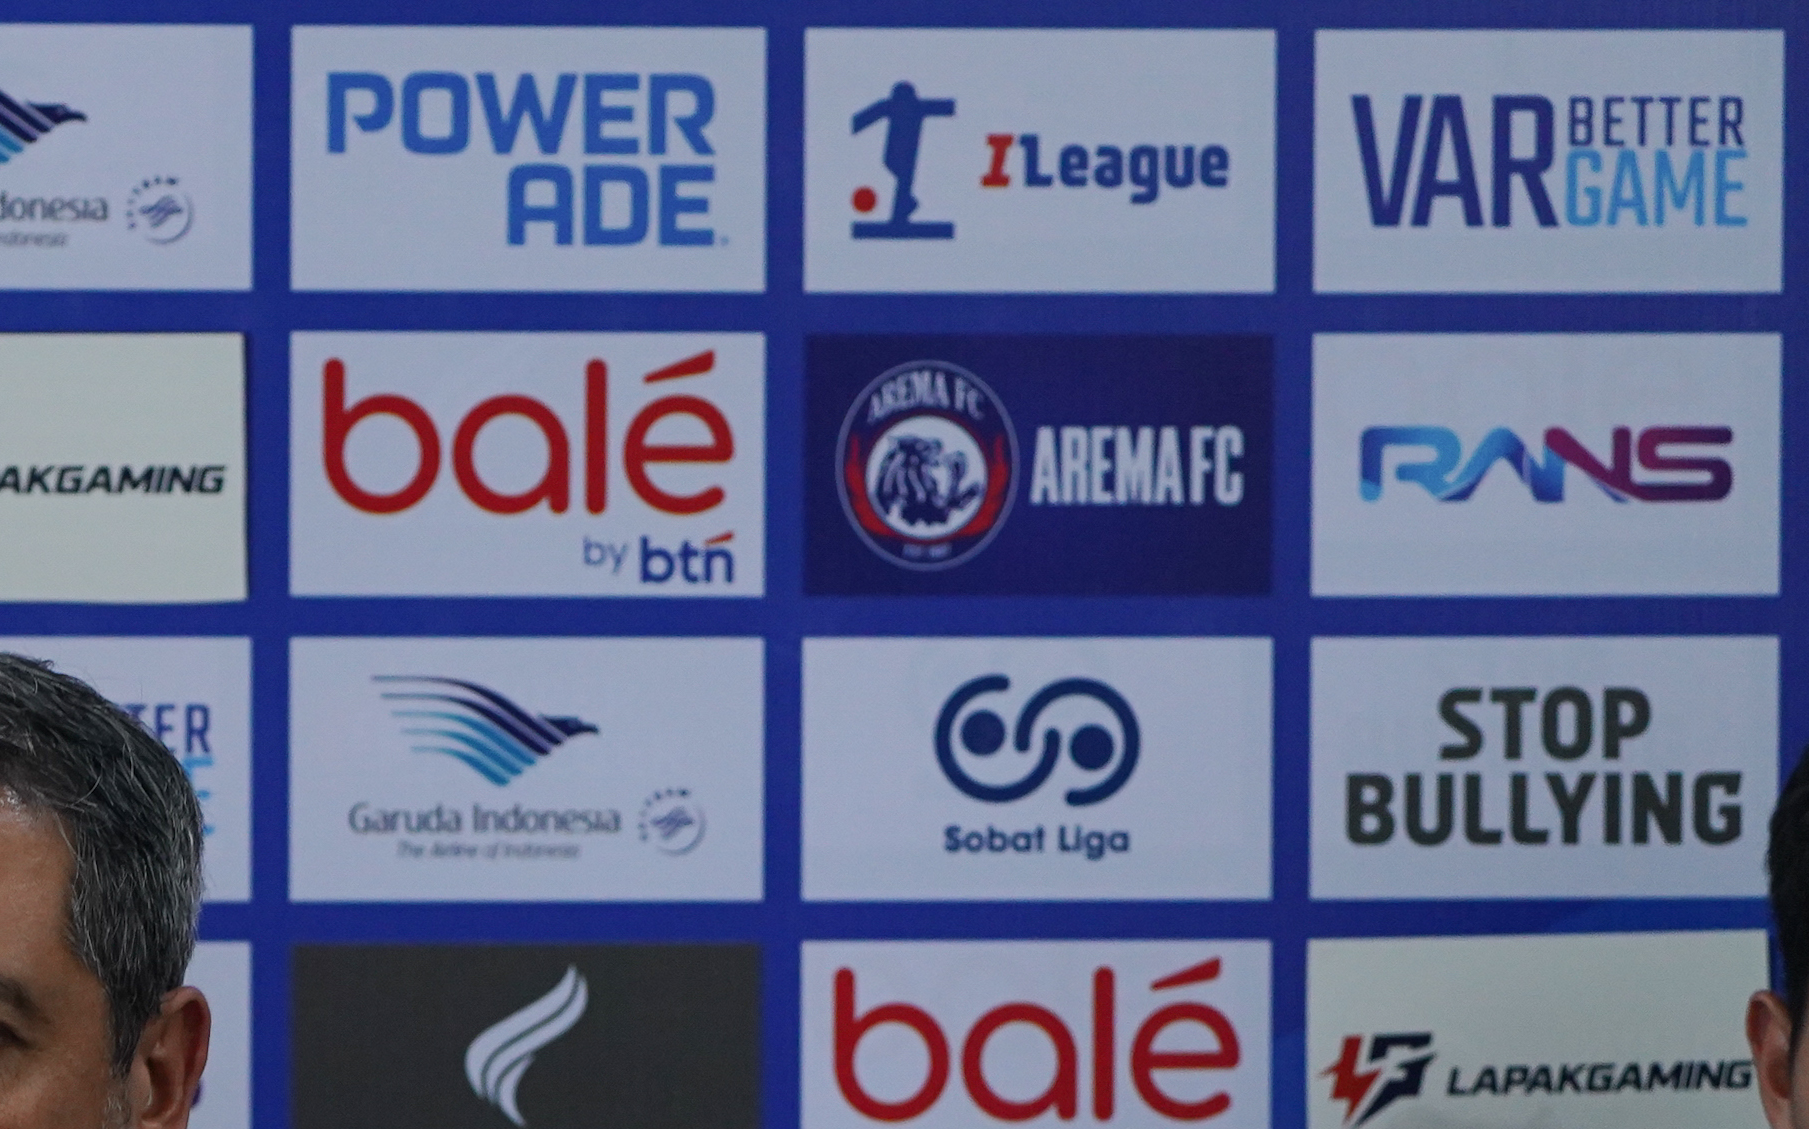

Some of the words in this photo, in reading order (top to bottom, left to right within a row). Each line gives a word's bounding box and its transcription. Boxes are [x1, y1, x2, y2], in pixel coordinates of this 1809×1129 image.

[326, 70, 716, 156] POWER
[1567, 95, 1745, 147] BETTER
[1350, 93, 1560, 228] VAR
[1564, 149, 1749, 227] GAME
[506, 162, 717, 247] ADE
[322, 349, 737, 516] balé
[1029, 426, 1184, 505] AREMA
[1189, 426, 1244, 505] FC
[1359, 425, 1734, 504] RANS
[583, 536, 628, 573] by
[1437, 685, 1652, 761] STOP
[347, 802, 464, 835] Garuda
[471, 802, 622, 835] Indonesia
[943, 824, 1046, 853] Sobat
[1057, 824, 1131, 861] Liga
[1345, 771, 1744, 848] BULLYING
[832, 957, 1242, 1124] balé
[1446, 1059, 1753, 1097] LAPAKGAMING
